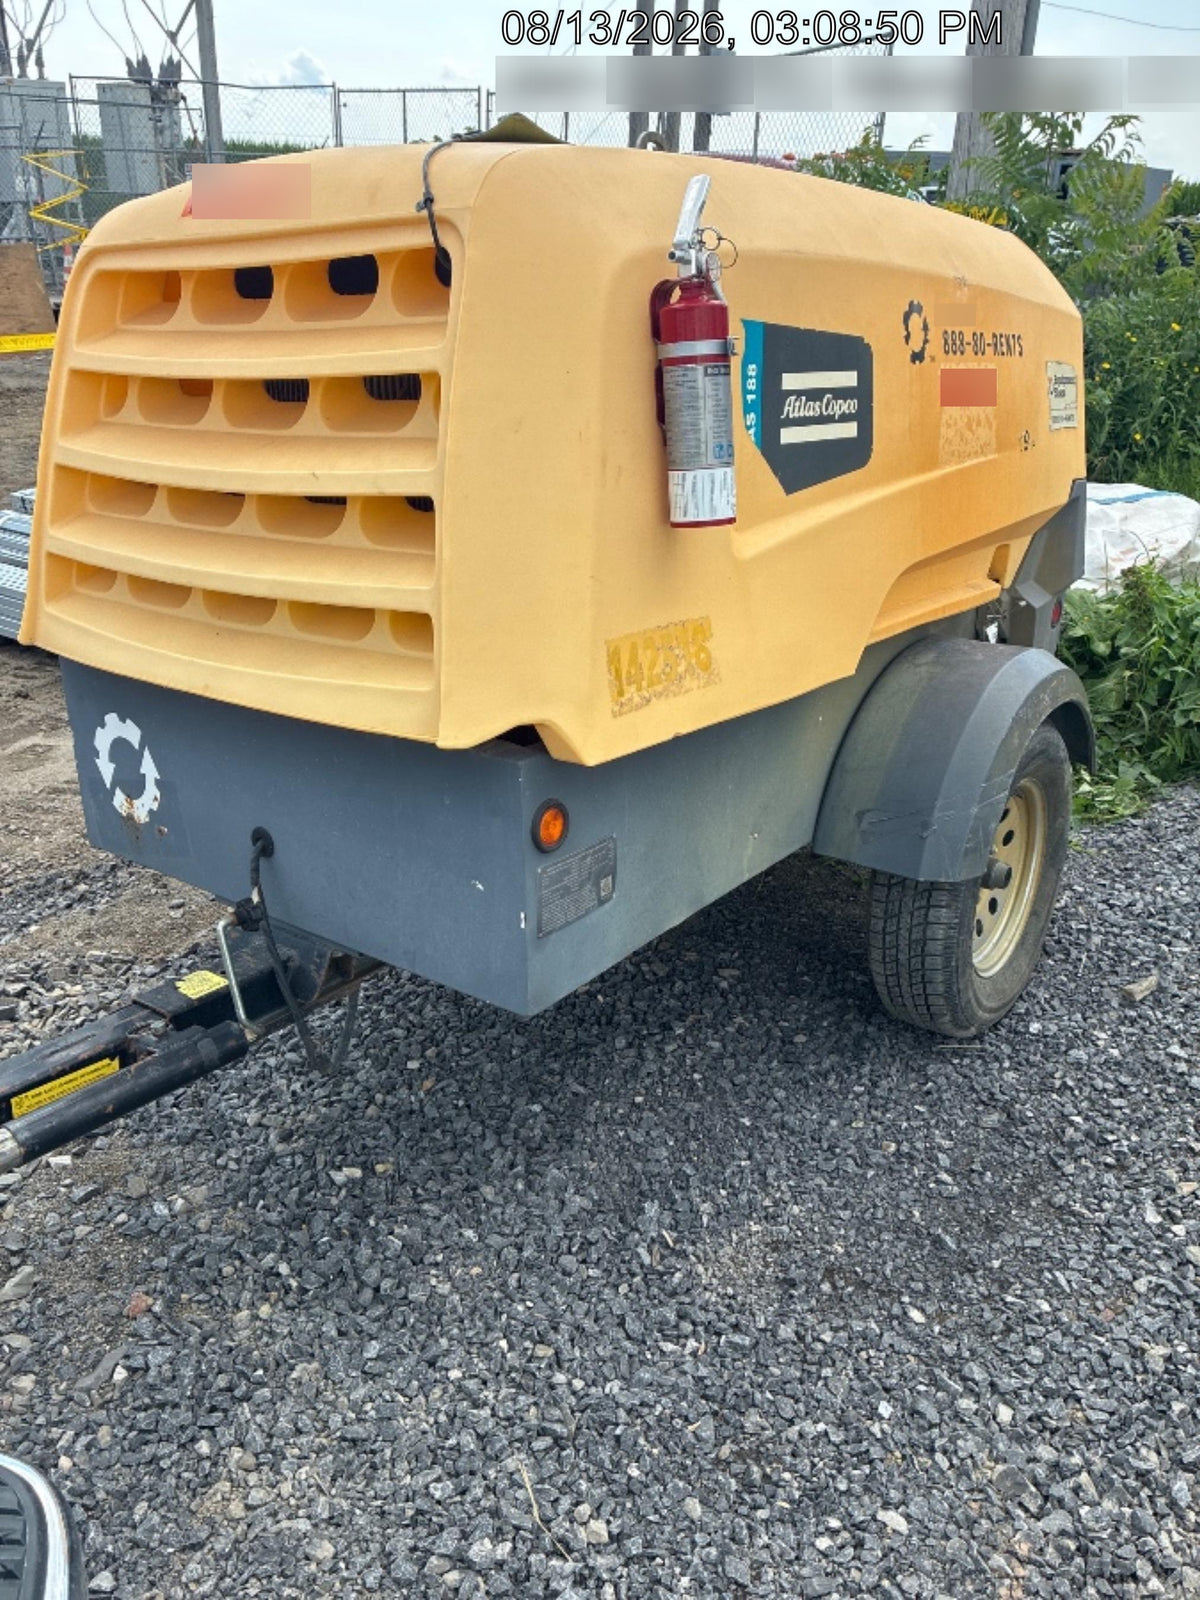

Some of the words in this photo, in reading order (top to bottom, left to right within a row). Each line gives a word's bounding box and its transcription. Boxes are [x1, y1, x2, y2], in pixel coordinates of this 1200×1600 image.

[746, 364, 758, 404] 188
[780, 395, 821, 419] Atlas
[821, 394, 858, 420] Copco
